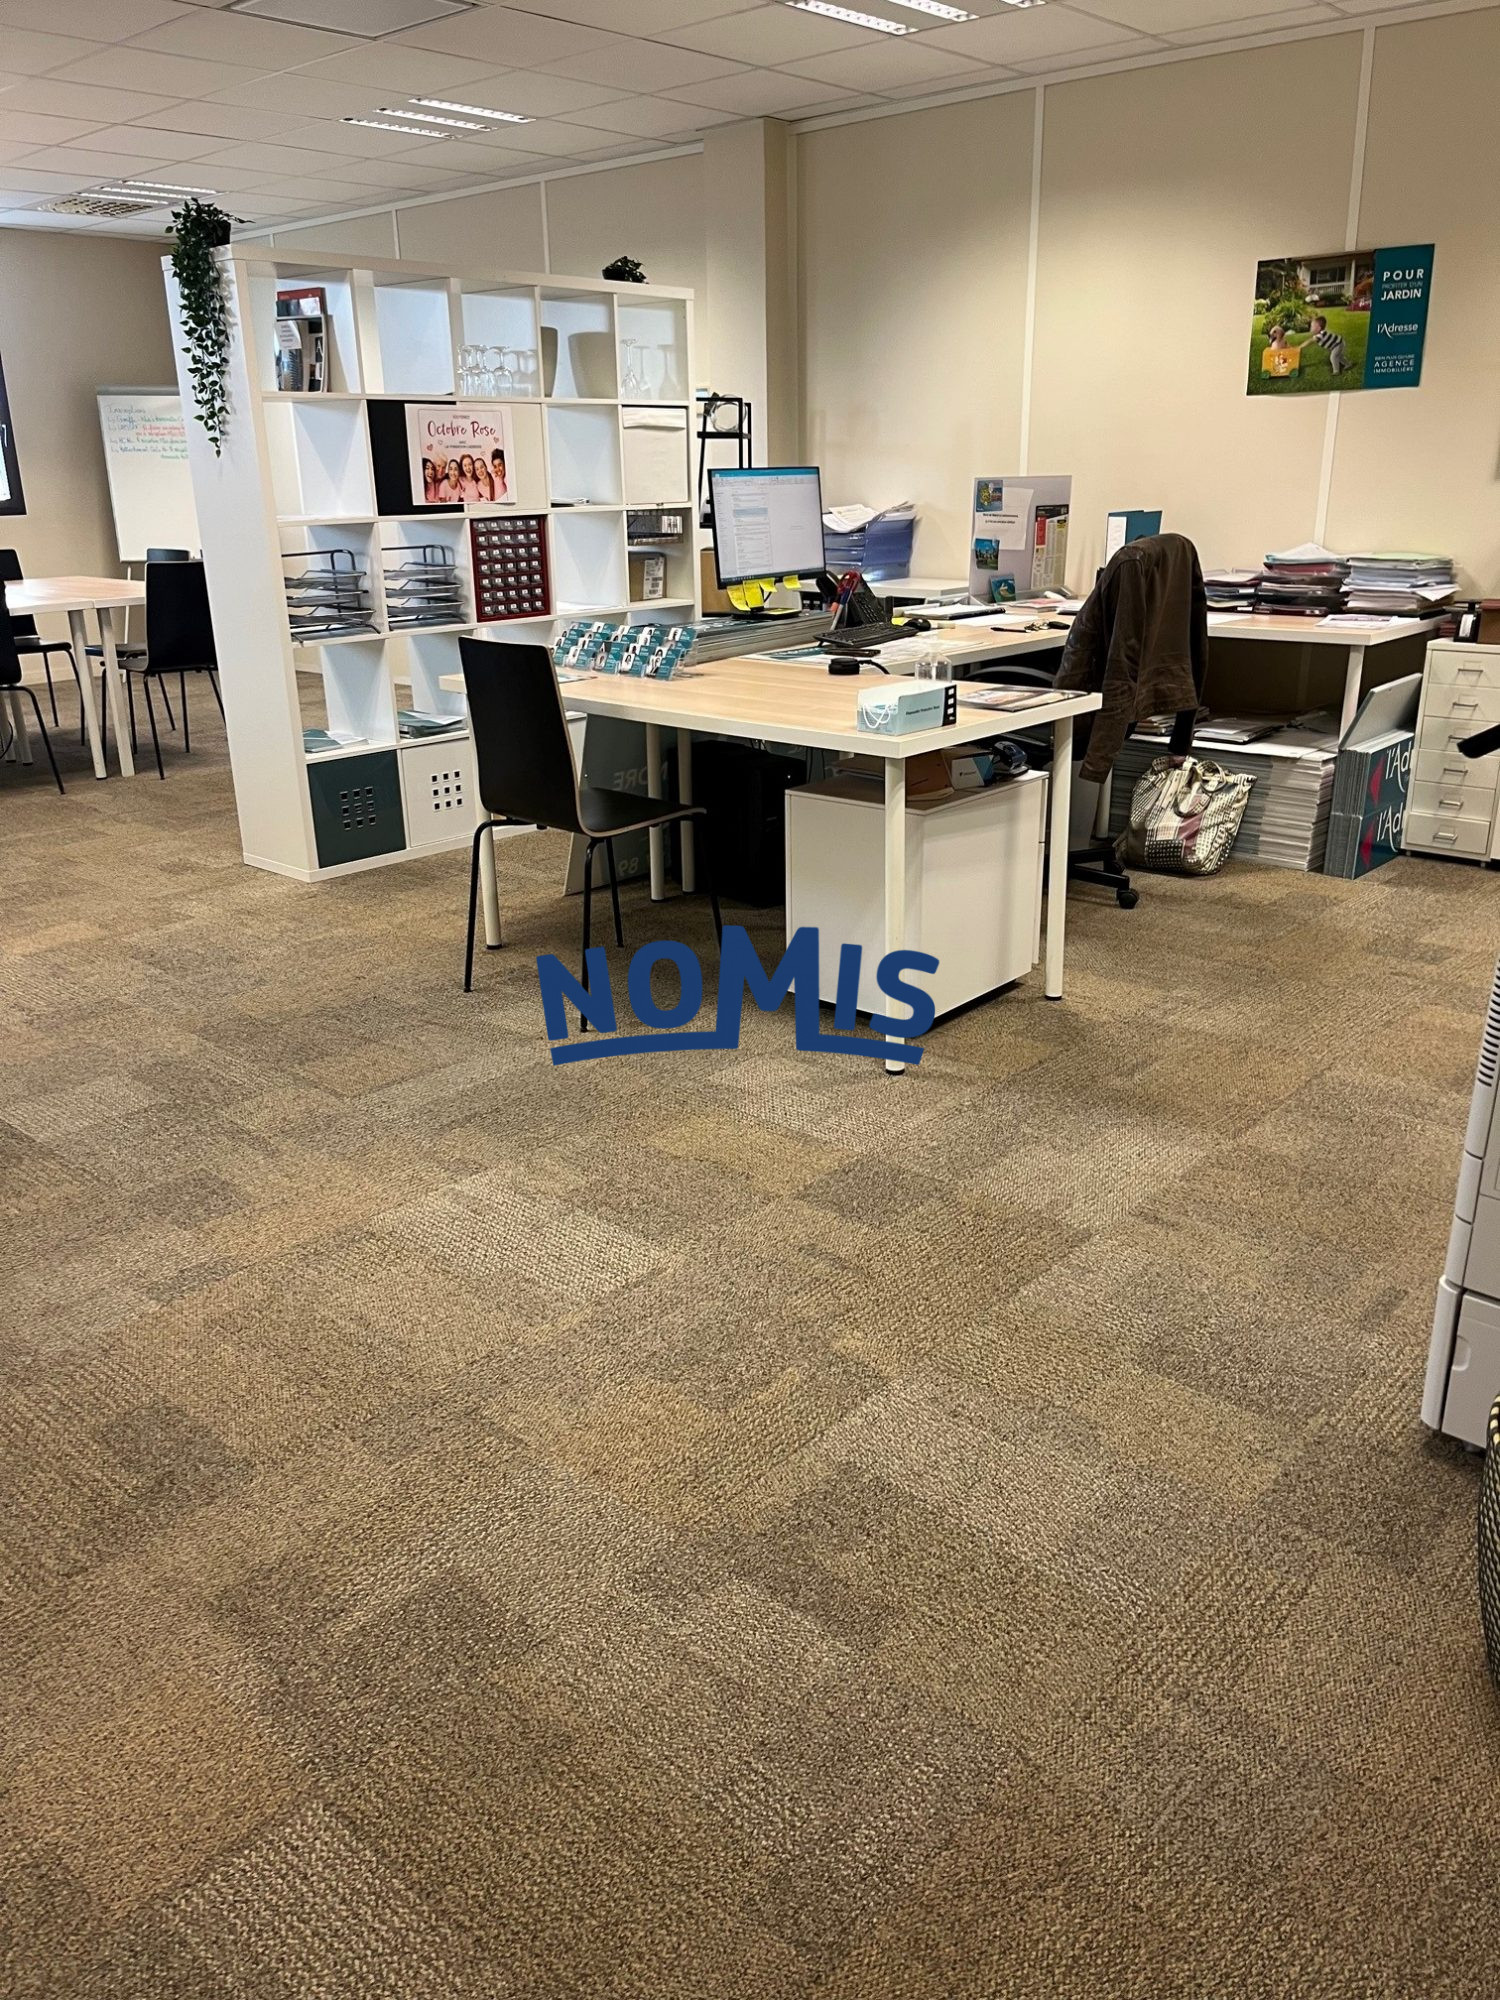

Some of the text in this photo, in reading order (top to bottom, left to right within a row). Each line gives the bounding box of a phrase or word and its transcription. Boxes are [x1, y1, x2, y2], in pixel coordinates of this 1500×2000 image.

[1383, 268, 1424, 282] POUR
[1380, 288, 1422, 301] JARDIN
[1377, 322, 1418, 340] l'Adresse
[1374, 359, 1415, 368] AGENCE
[427, 420, 496, 438] Octobre Rose
